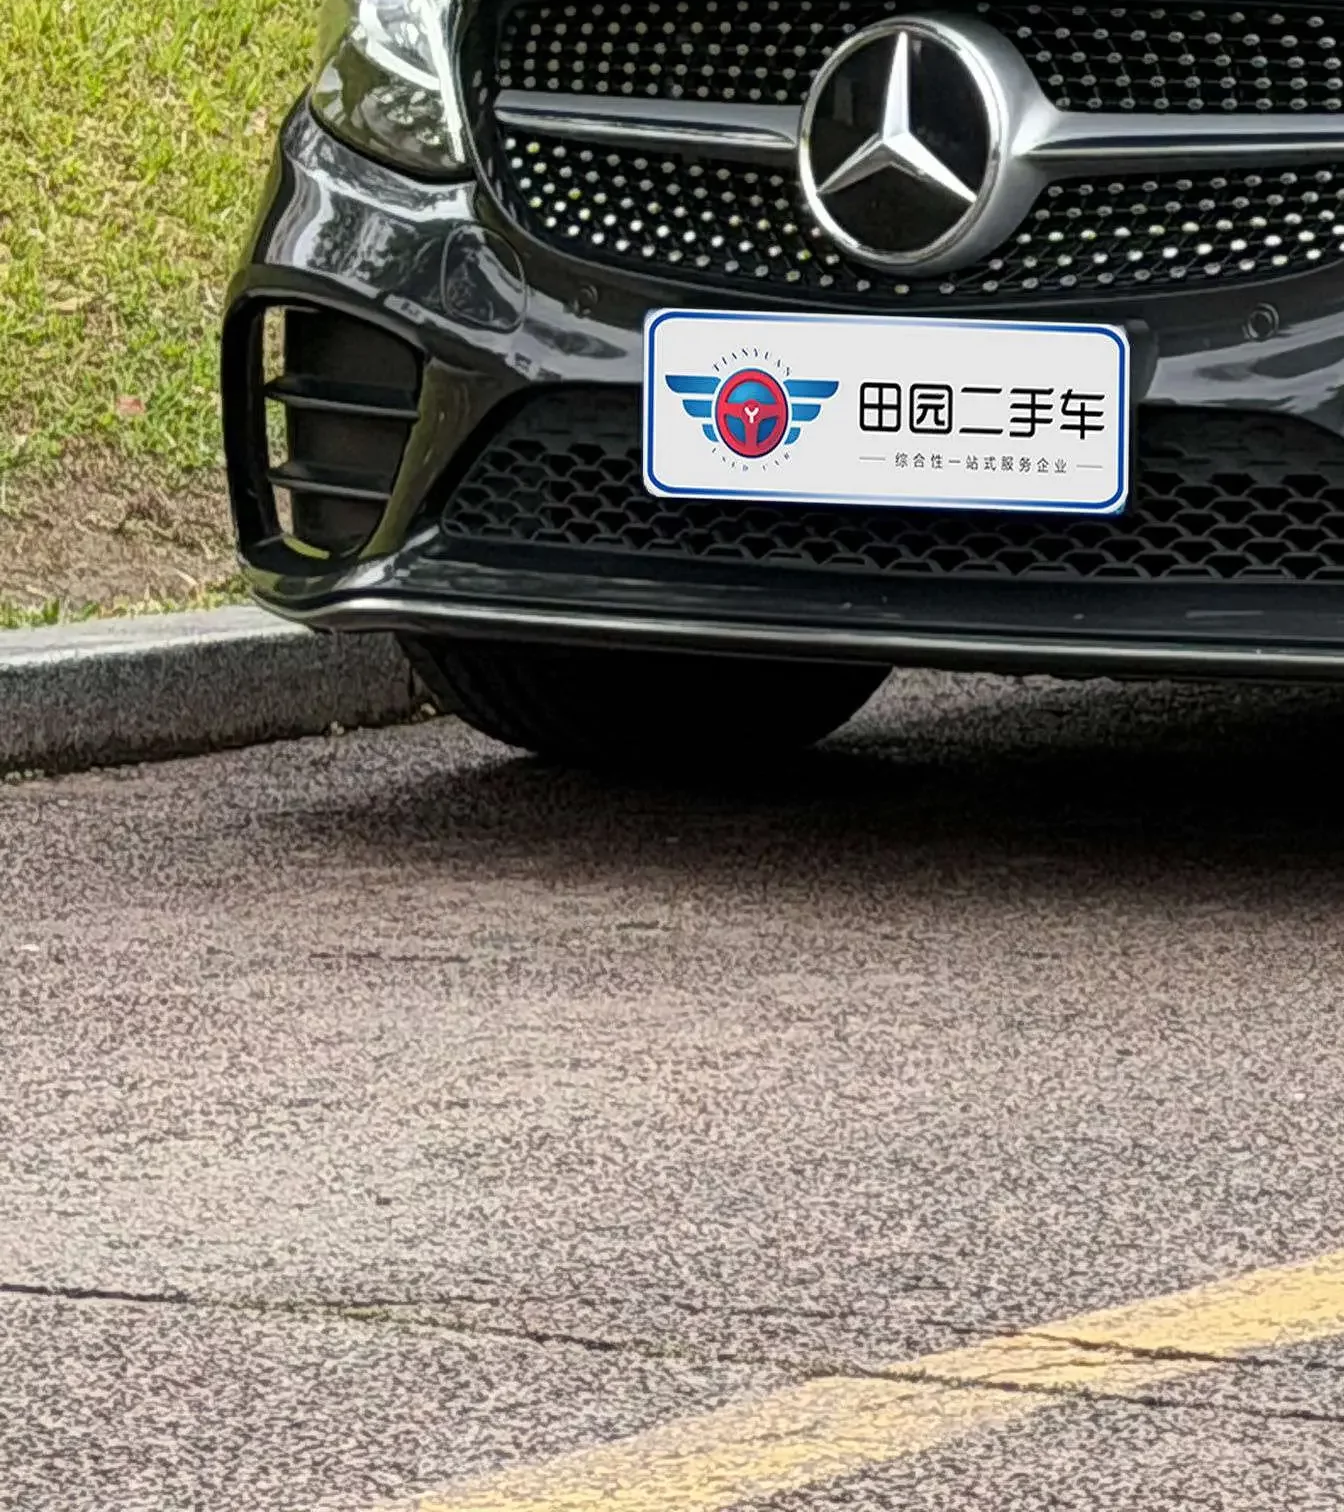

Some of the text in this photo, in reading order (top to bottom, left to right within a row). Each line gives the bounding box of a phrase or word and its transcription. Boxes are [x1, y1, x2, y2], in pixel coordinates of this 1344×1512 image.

[859, 381, 1106, 440] 田园二手车
[895, 452, 1067, 474] 综合性一站式服务企业
